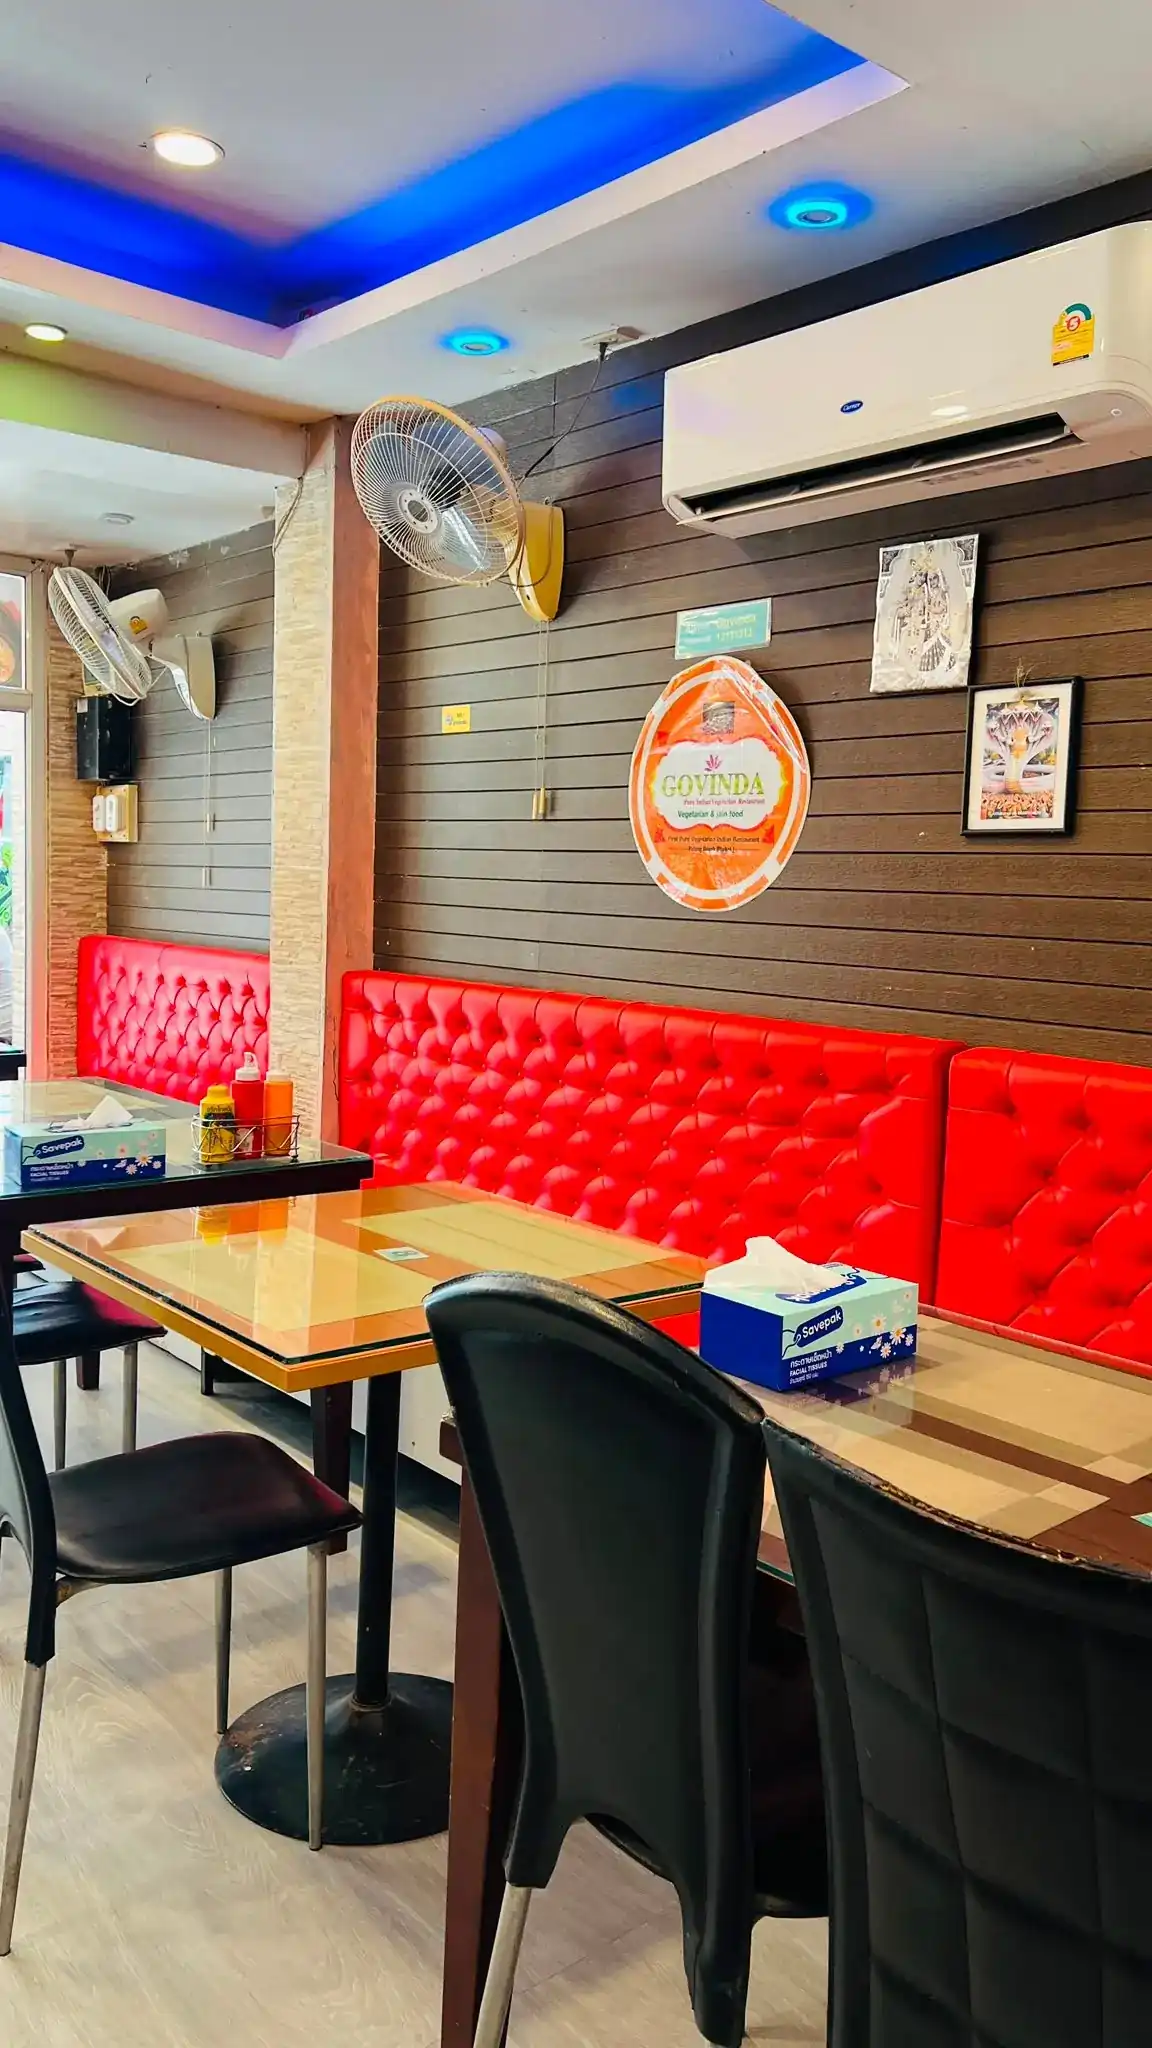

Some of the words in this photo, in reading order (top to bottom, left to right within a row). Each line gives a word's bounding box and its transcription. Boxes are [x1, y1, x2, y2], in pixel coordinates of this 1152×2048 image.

[662, 772, 764, 797] GOVINDA
[678, 810, 709, 819] Vegetarian
[729, 810, 744, 818] food
[41, 1138, 83, 1154] Savepak
[802, 1310, 842, 1338] Savepak
[789, 1367, 808, 1377] FACIAL
[808, 1361, 828, 1372] TISSUES
